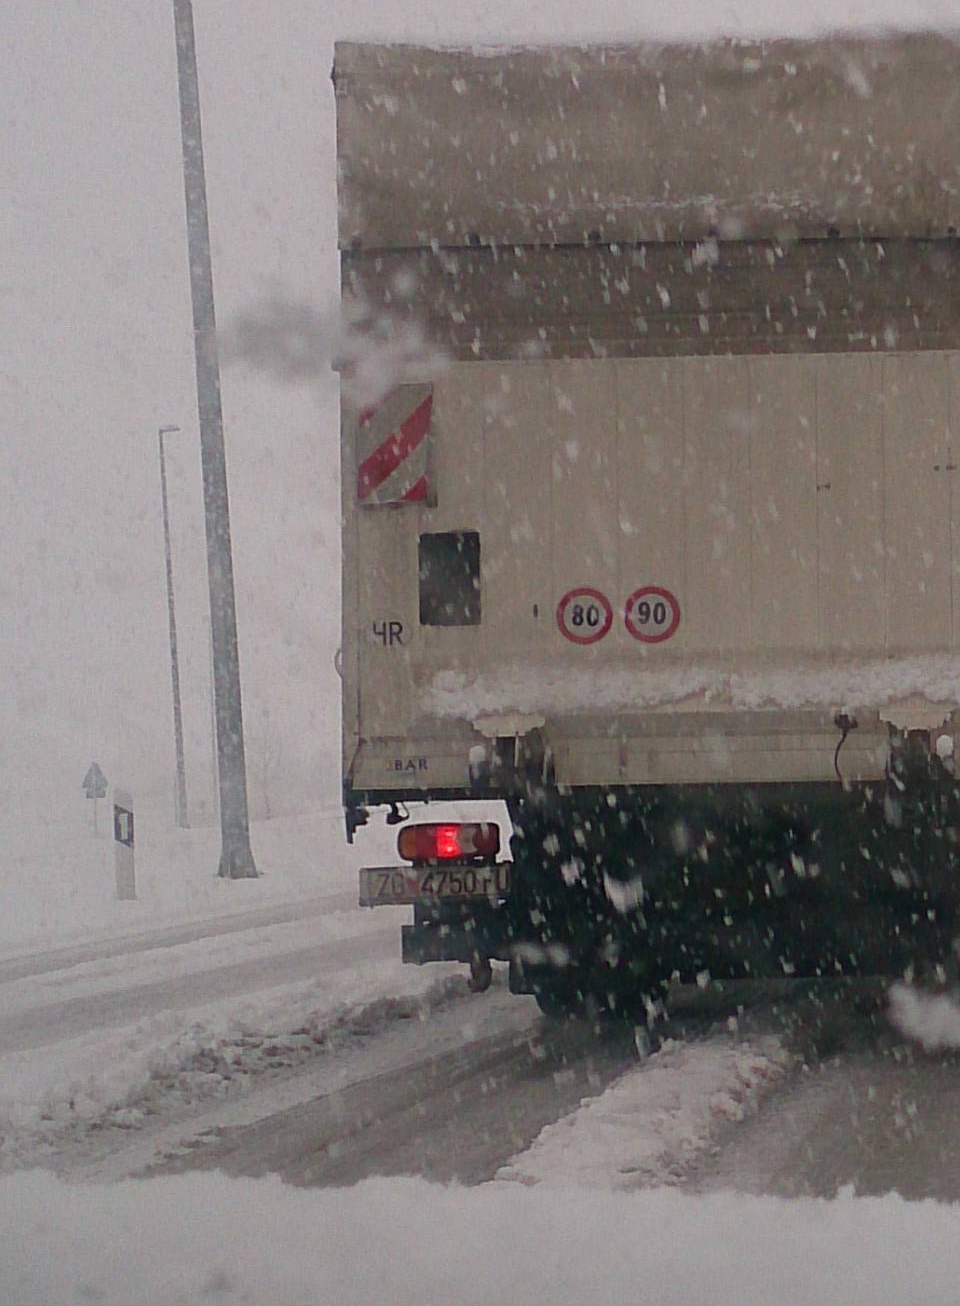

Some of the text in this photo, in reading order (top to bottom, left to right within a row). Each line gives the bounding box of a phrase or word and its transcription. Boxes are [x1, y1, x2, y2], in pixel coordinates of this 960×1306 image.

[572, 604, 599, 627] 80
[638, 601, 666, 625] 90
[376, 873, 405, 896] ZG
[420, 869, 477, 896] 4750
